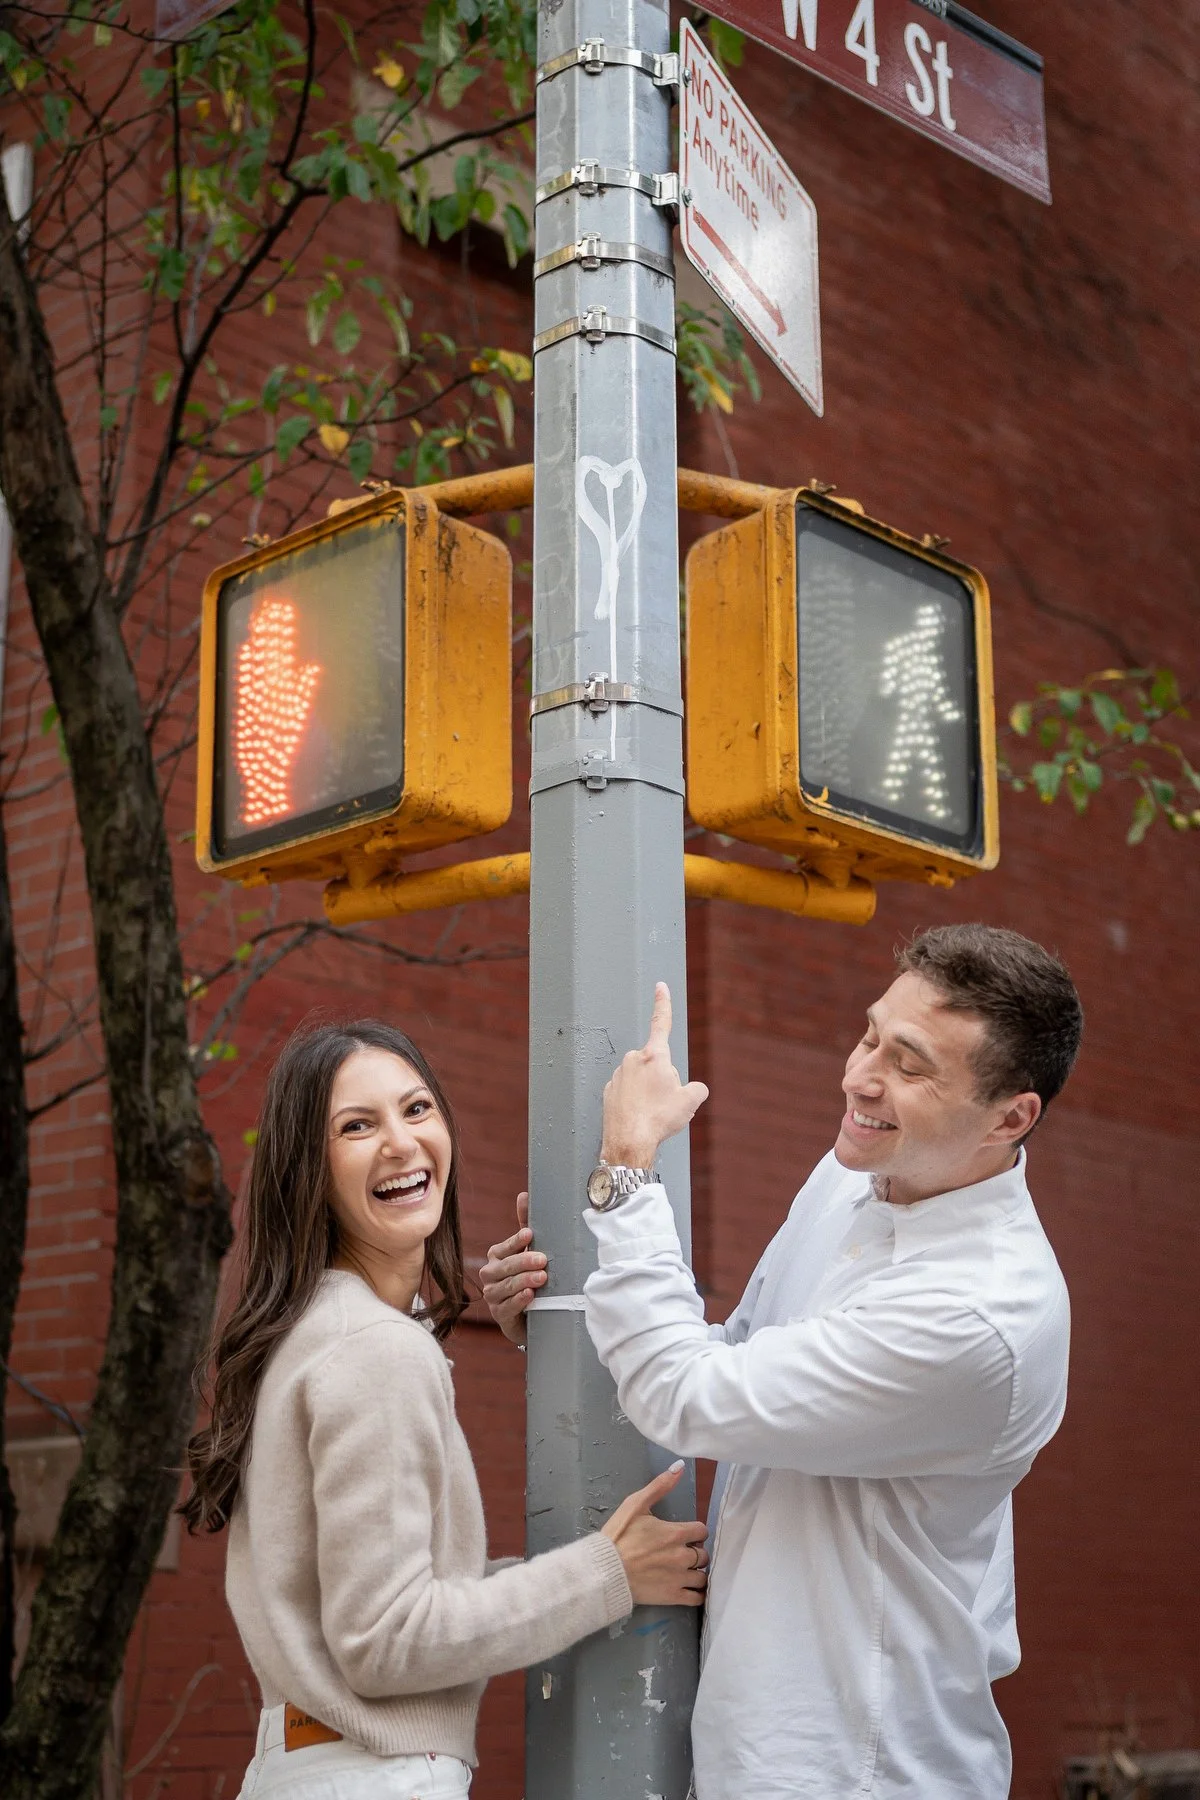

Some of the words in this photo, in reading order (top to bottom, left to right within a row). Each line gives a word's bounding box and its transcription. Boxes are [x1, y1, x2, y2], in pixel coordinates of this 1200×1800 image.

[845, 0, 880, 87] 4
[904, 22, 956, 132] St
[691, 59, 714, 119] NO
[720, 99, 788, 221] PARKING
[693, 115, 760, 232] Anytime
